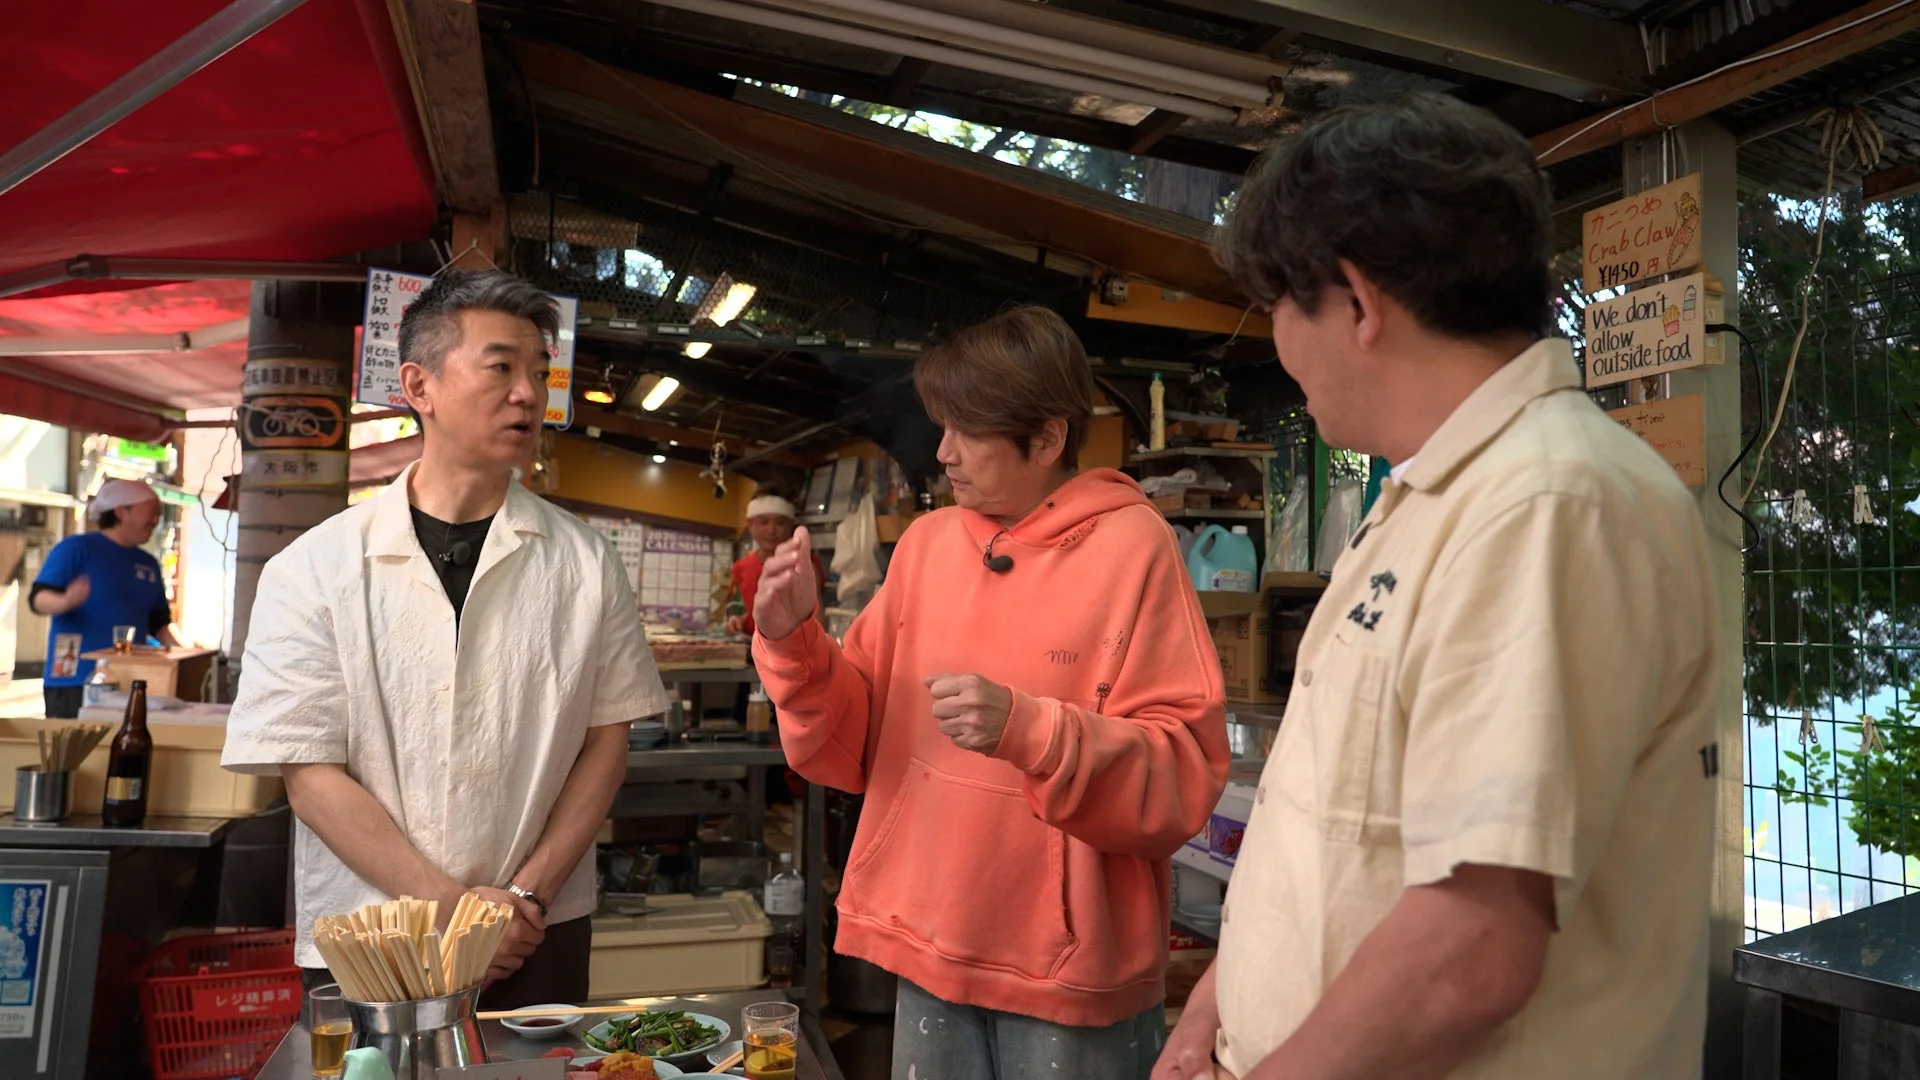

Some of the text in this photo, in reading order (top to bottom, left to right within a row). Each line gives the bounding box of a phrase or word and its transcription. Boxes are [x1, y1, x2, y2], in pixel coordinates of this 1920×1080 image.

[1591, 197, 1662, 236] カニつめ
[1589, 219, 1677, 264] Crab Claw
[398, 276, 422, 293] 600
[1593, 291, 1668, 330] We don't
[1592, 330, 1634, 355] allow
[1593, 333, 1691, 377] outside food
[264, 460, 318, 474] 大阪市
